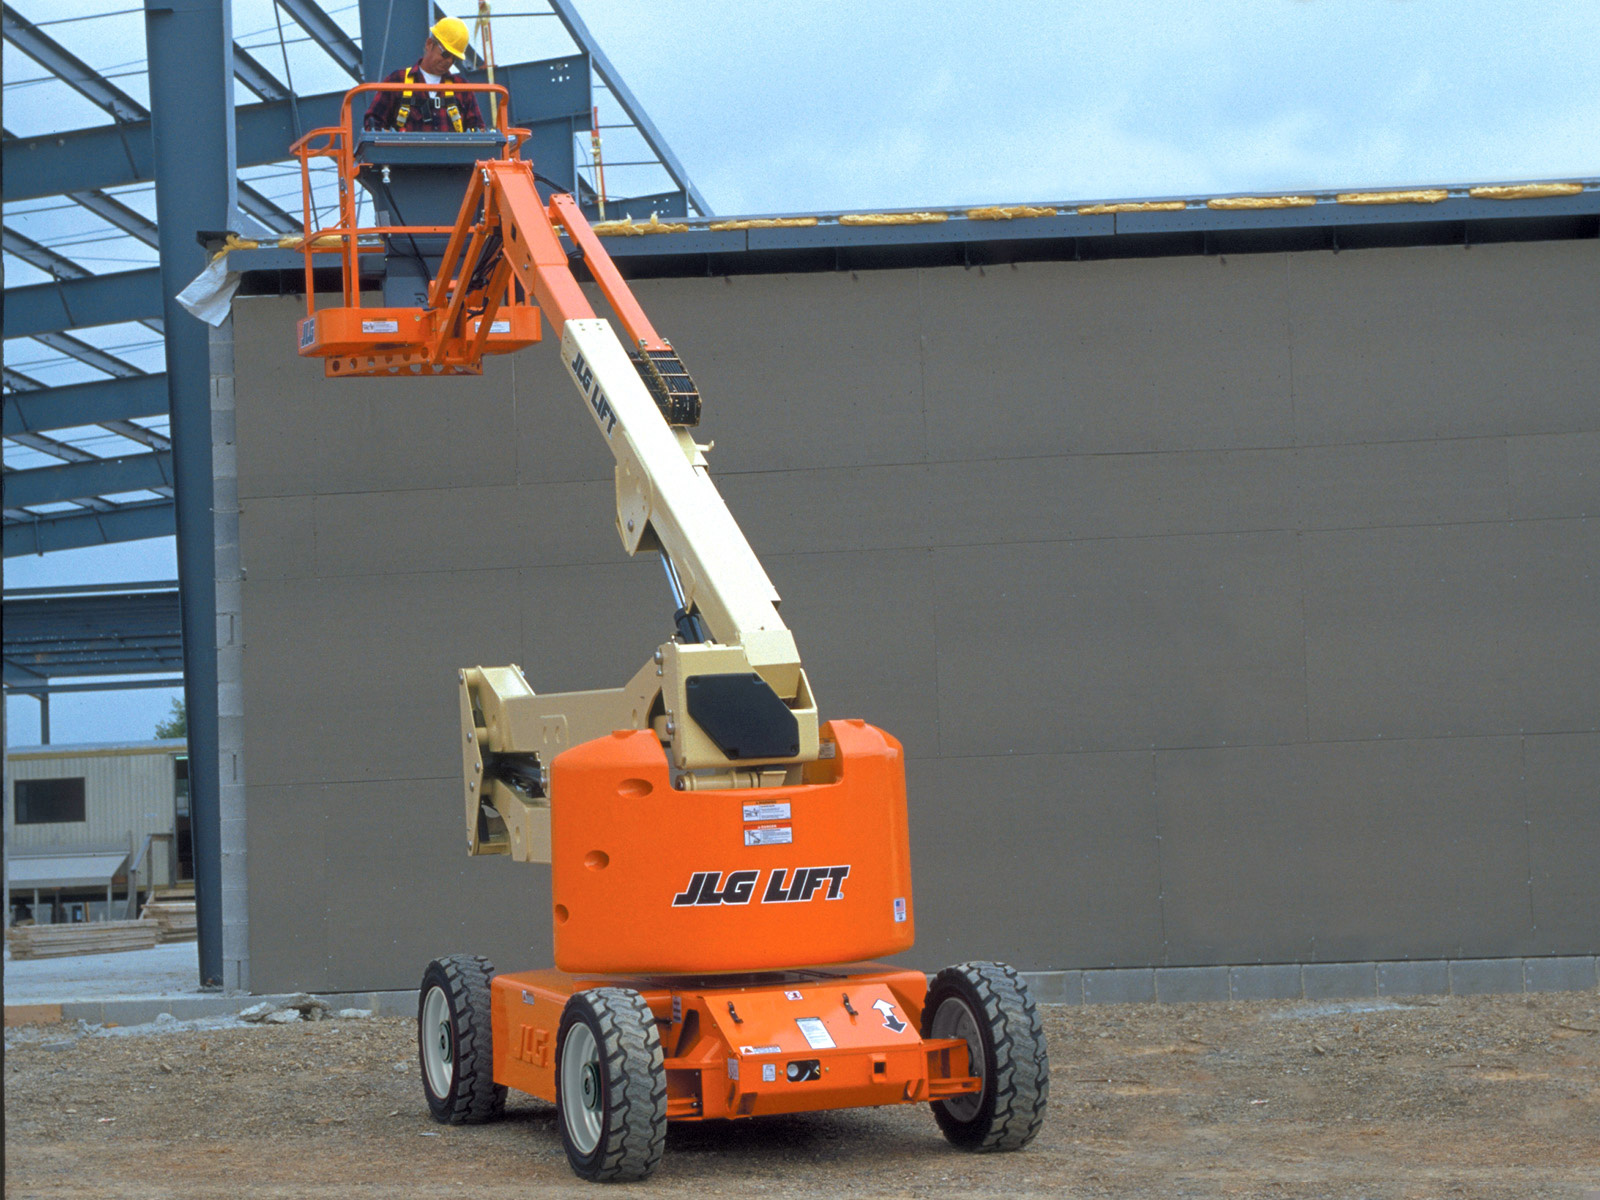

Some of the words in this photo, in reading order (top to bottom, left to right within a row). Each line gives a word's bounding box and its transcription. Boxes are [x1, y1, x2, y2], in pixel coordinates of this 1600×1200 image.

[301, 318, 315, 348] JLG
[571, 351, 593, 395] JLG
[591, 382, 617, 436] LIFT
[672, 870, 760, 907] JLG
[761, 865, 851, 904] LIFT
[512, 1024, 550, 1068] JLG
